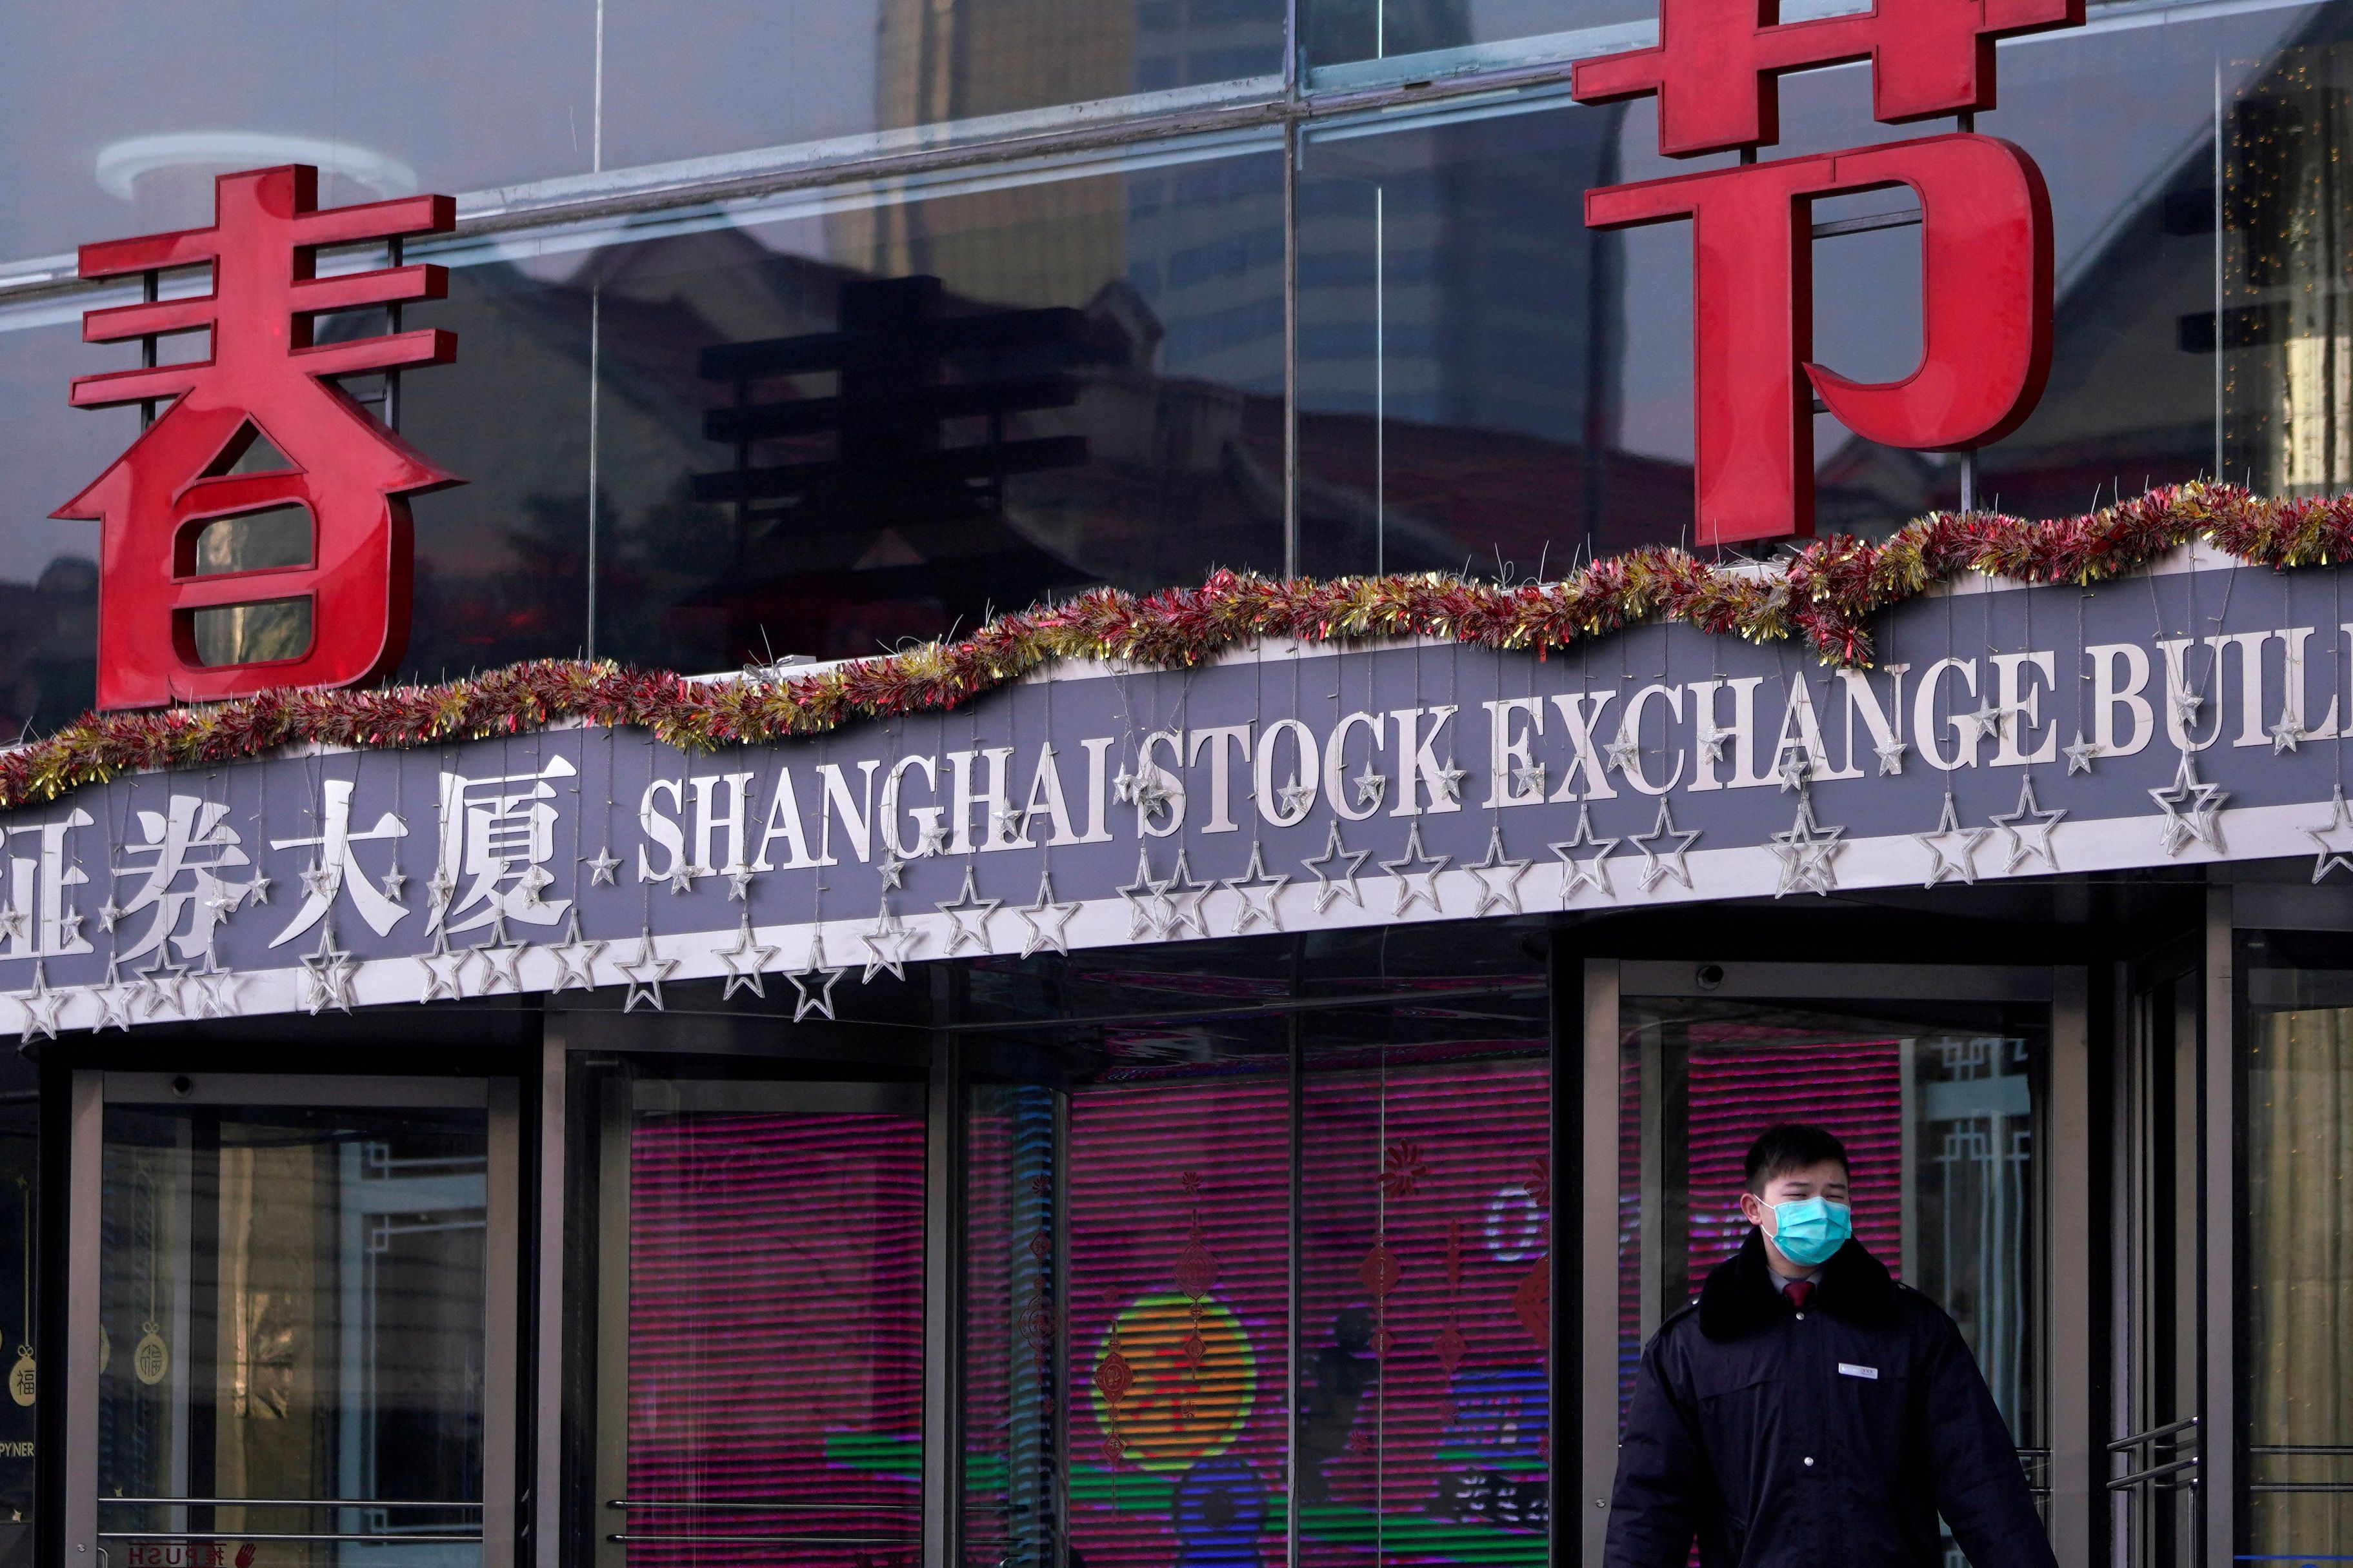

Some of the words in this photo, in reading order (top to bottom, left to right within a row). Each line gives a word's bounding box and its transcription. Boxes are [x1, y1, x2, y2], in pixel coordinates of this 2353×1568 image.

[48, 164, 471, 711] 春
[1572, 0, 2087, 547] 节
[638, 737, 1116, 884] SHANGHAI
[1137, 703, 1462, 840] STOCK
[1482, 650, 2058, 810] EXCHANGE
[2087, 622, 2353, 759] BUIL
